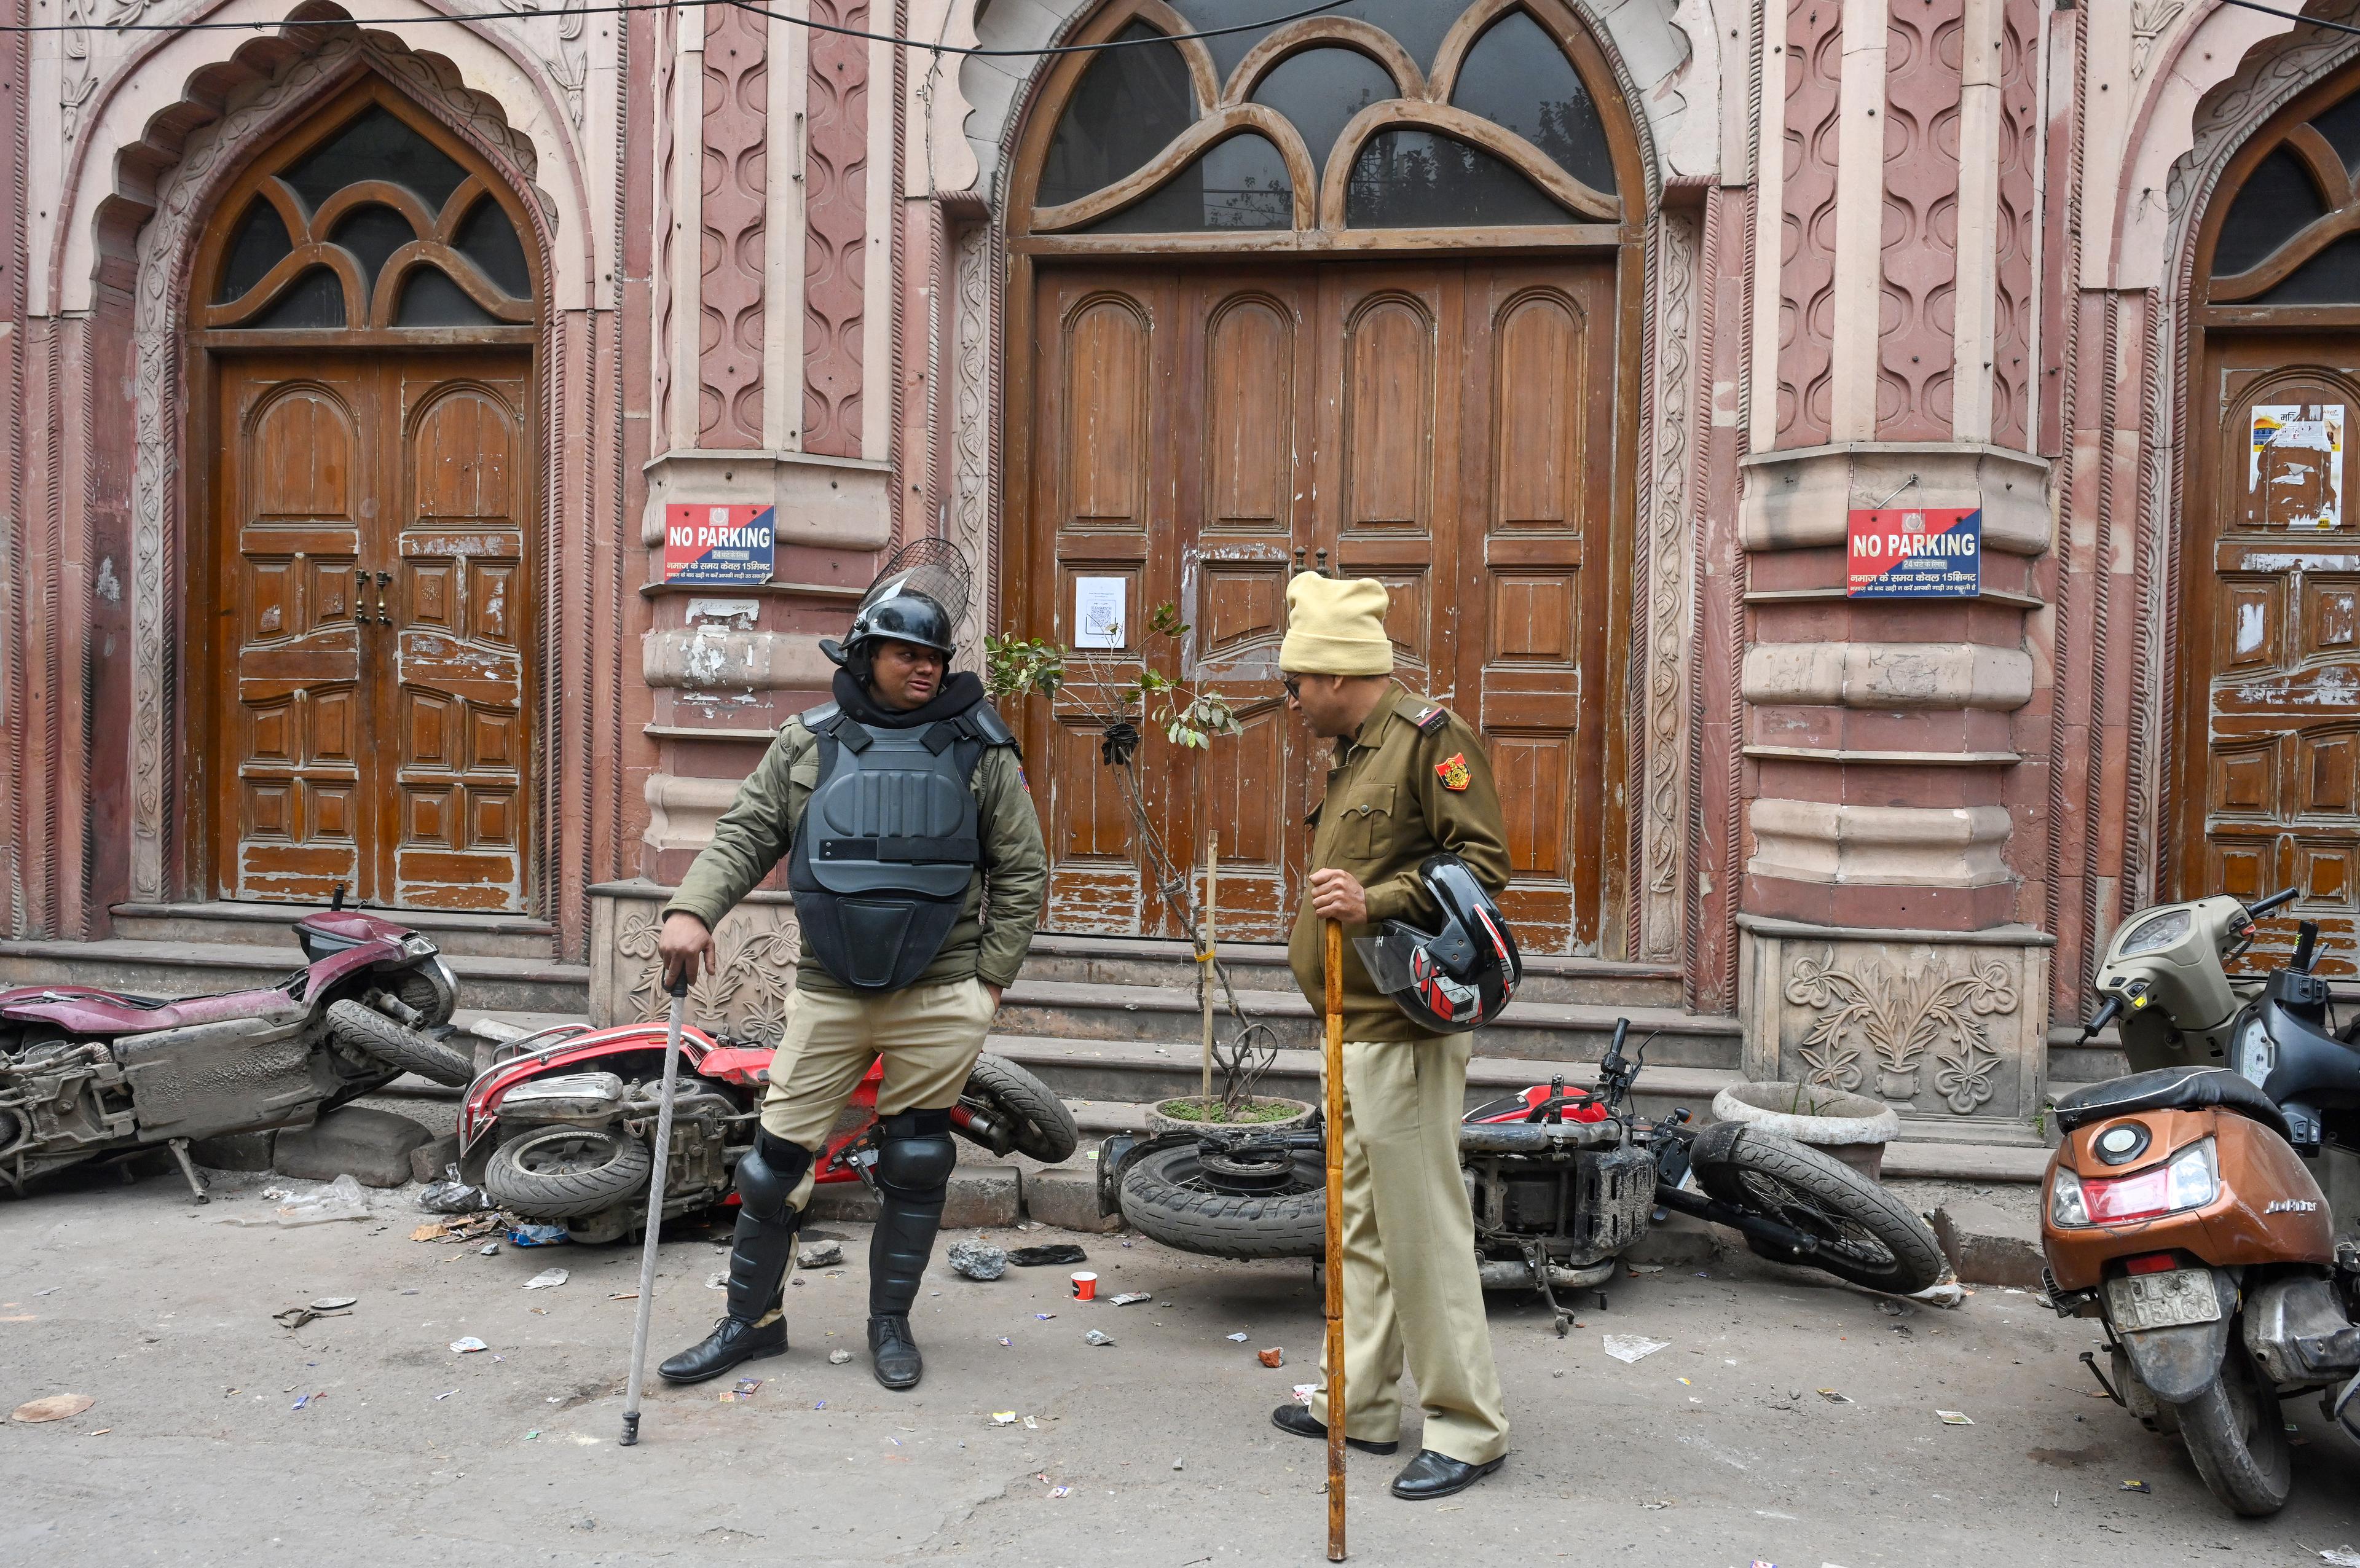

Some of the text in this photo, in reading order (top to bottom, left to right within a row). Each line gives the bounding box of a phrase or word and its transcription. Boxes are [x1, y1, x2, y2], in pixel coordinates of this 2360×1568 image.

[669, 527, 770, 548] NO PARKING
[1853, 533, 1975, 557] NO PARKING
[736, 551, 748, 559] लिए
[690, 560, 699, 569] के
[720, 561, 741, 570] केवल
[1932, 560, 1946, 569] लिए
[1879, 572, 1889, 582] के
[1916, 572, 1940, 582] केवल
